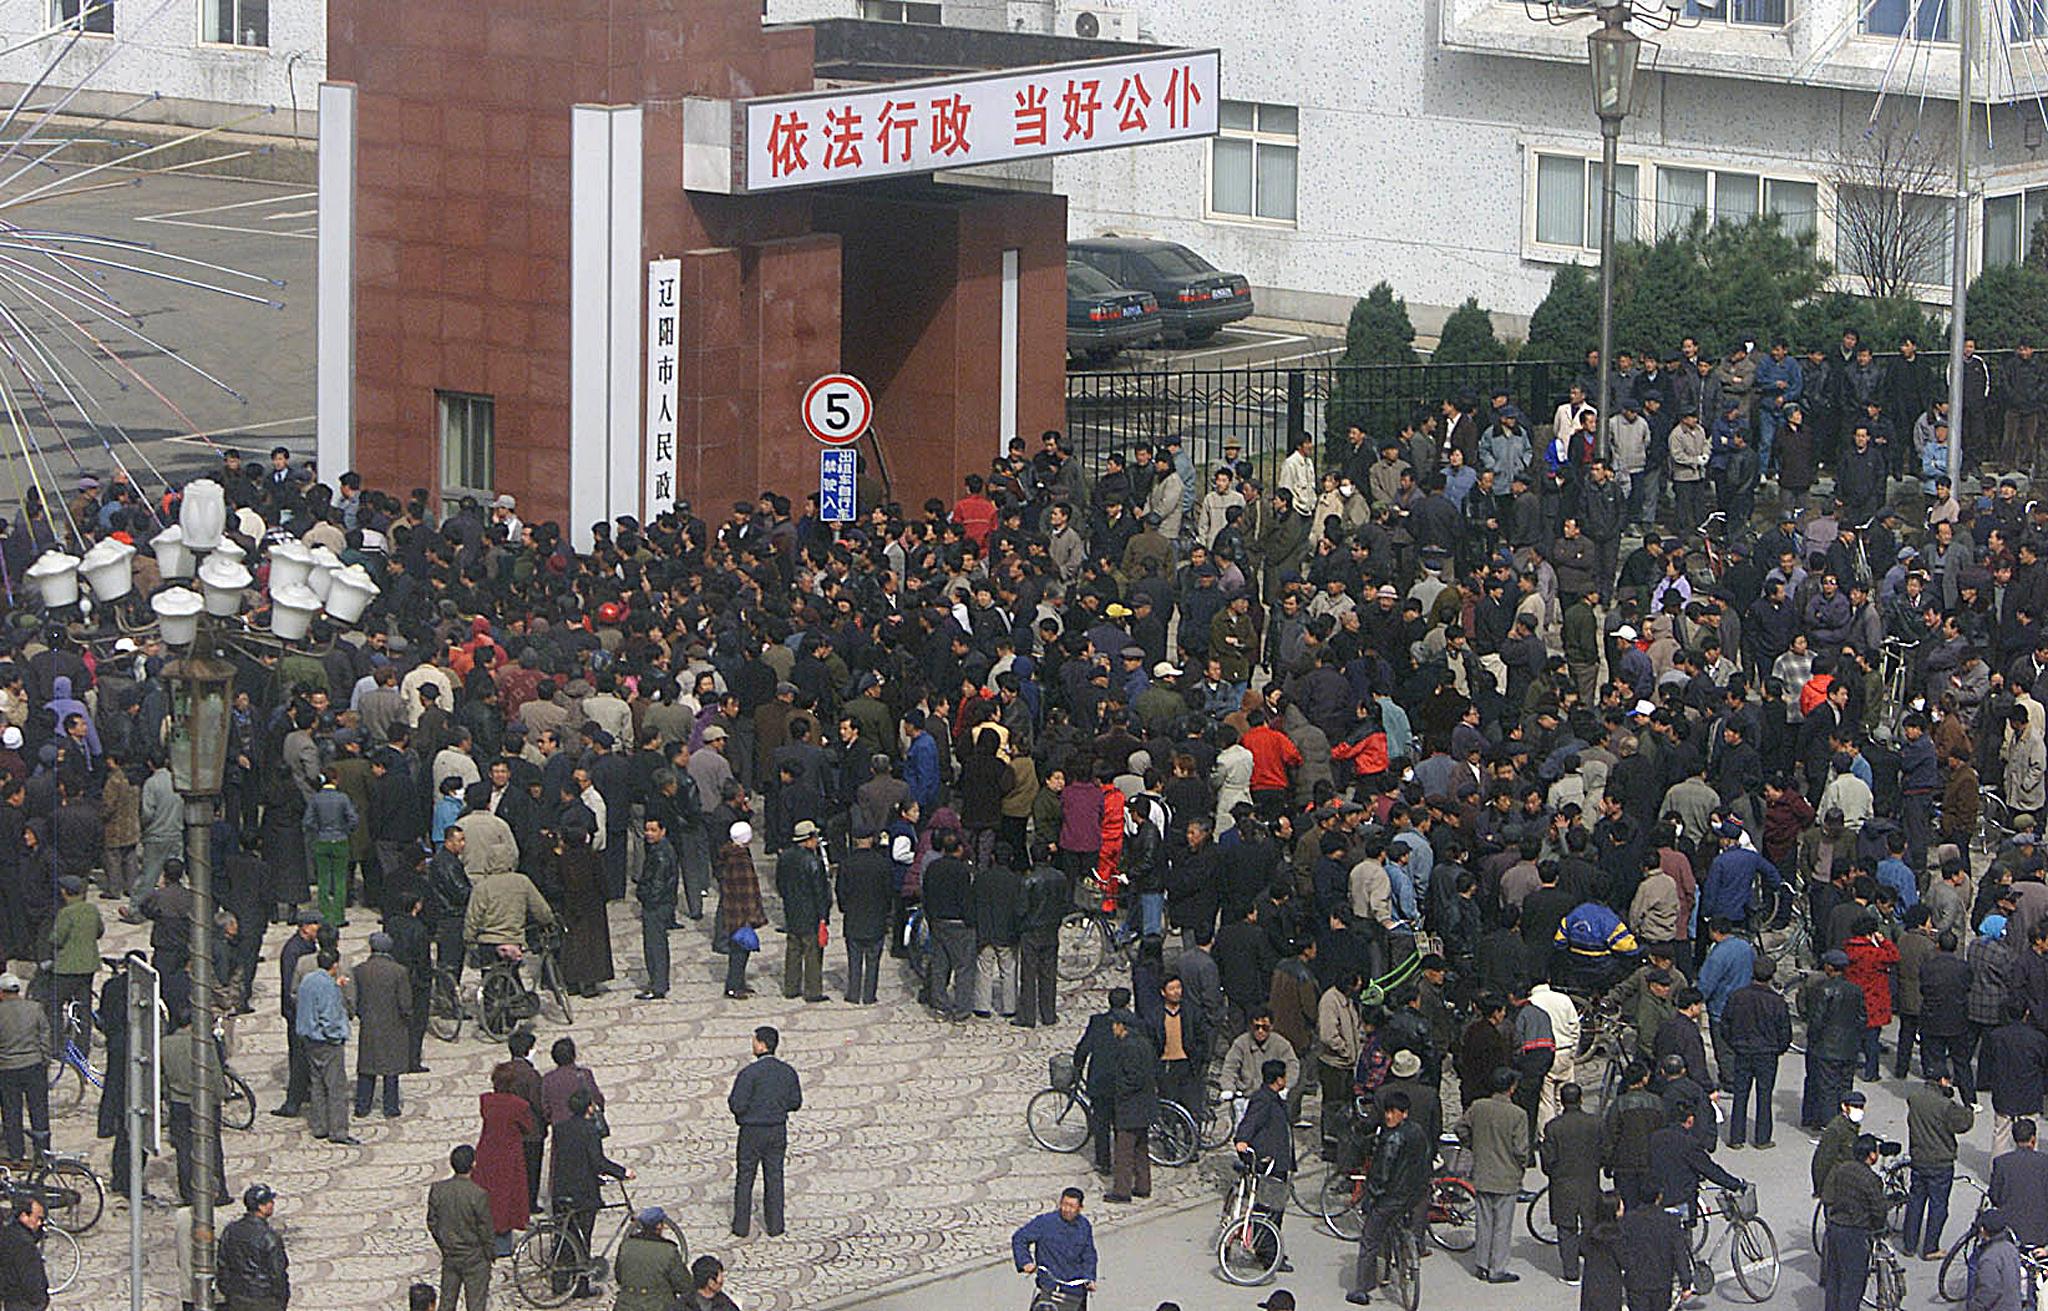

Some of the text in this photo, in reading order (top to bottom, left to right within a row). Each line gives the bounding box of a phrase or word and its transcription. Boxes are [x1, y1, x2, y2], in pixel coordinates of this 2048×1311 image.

[766, 93, 973, 178] 依法行政
[1013, 65, 1202, 148] 当好公仆
[655, 278, 675, 500] 辽阳市人民政
[826, 393, 850, 430] 5
